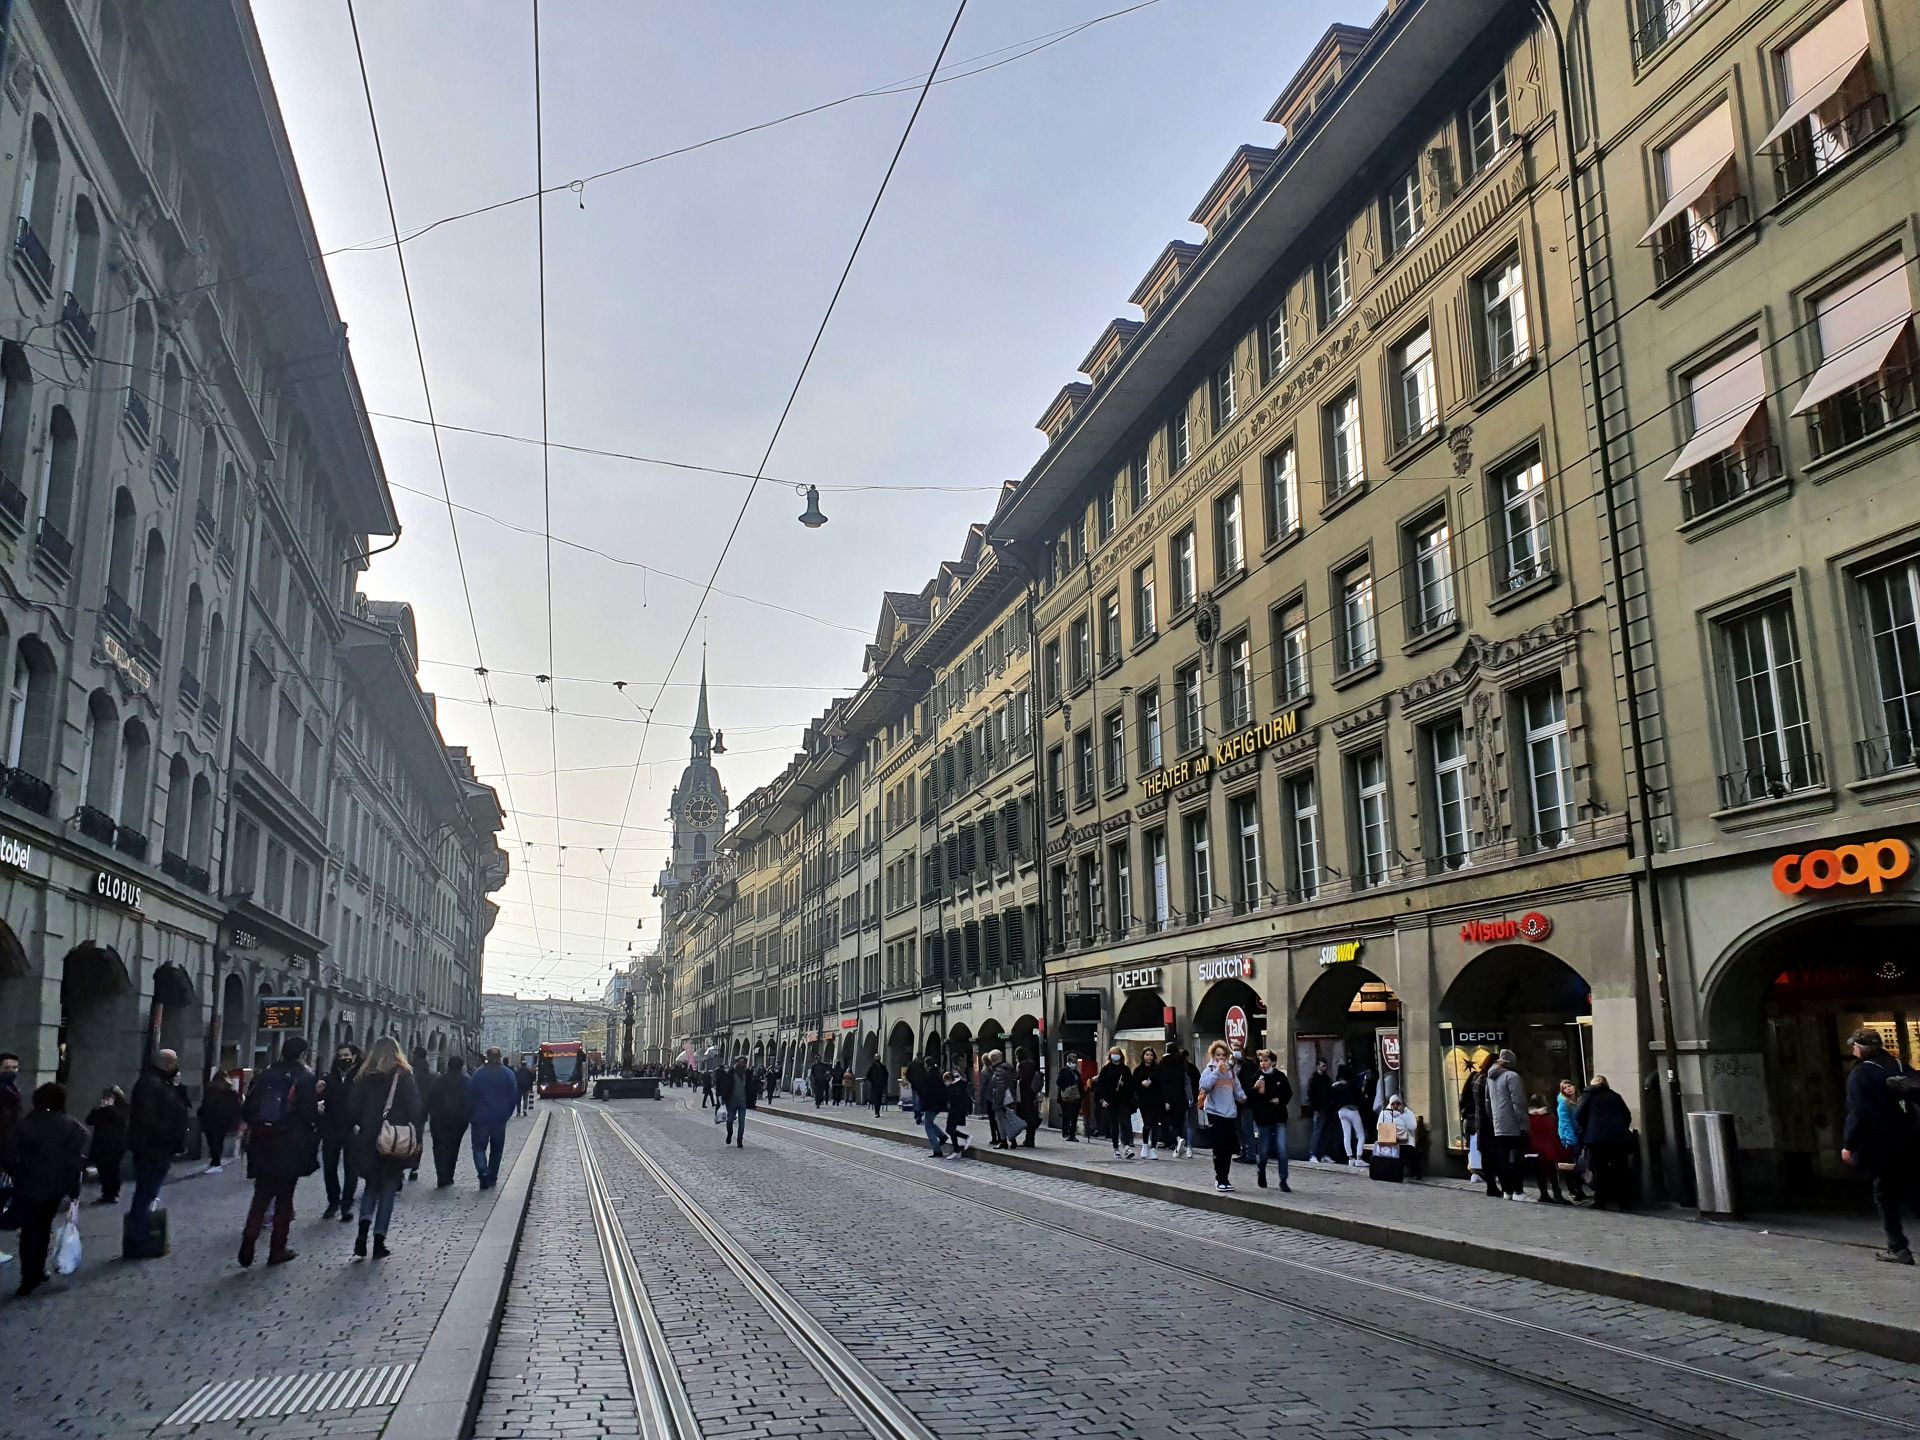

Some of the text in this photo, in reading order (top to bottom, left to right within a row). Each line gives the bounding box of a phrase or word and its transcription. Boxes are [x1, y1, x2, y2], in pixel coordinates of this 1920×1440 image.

[1142, 710, 1297, 799] THEATER AM KÄFIGTURM
[1772, 838, 1910, 895] coop
[98, 872, 142, 909] GLOBUS
[1319, 940, 1360, 965] SUBWAY
[1116, 966, 1158, 990] DEPOT
[1199, 954, 1243, 980] swatch
[1459, 1032, 1504, 1042] DEPOT
